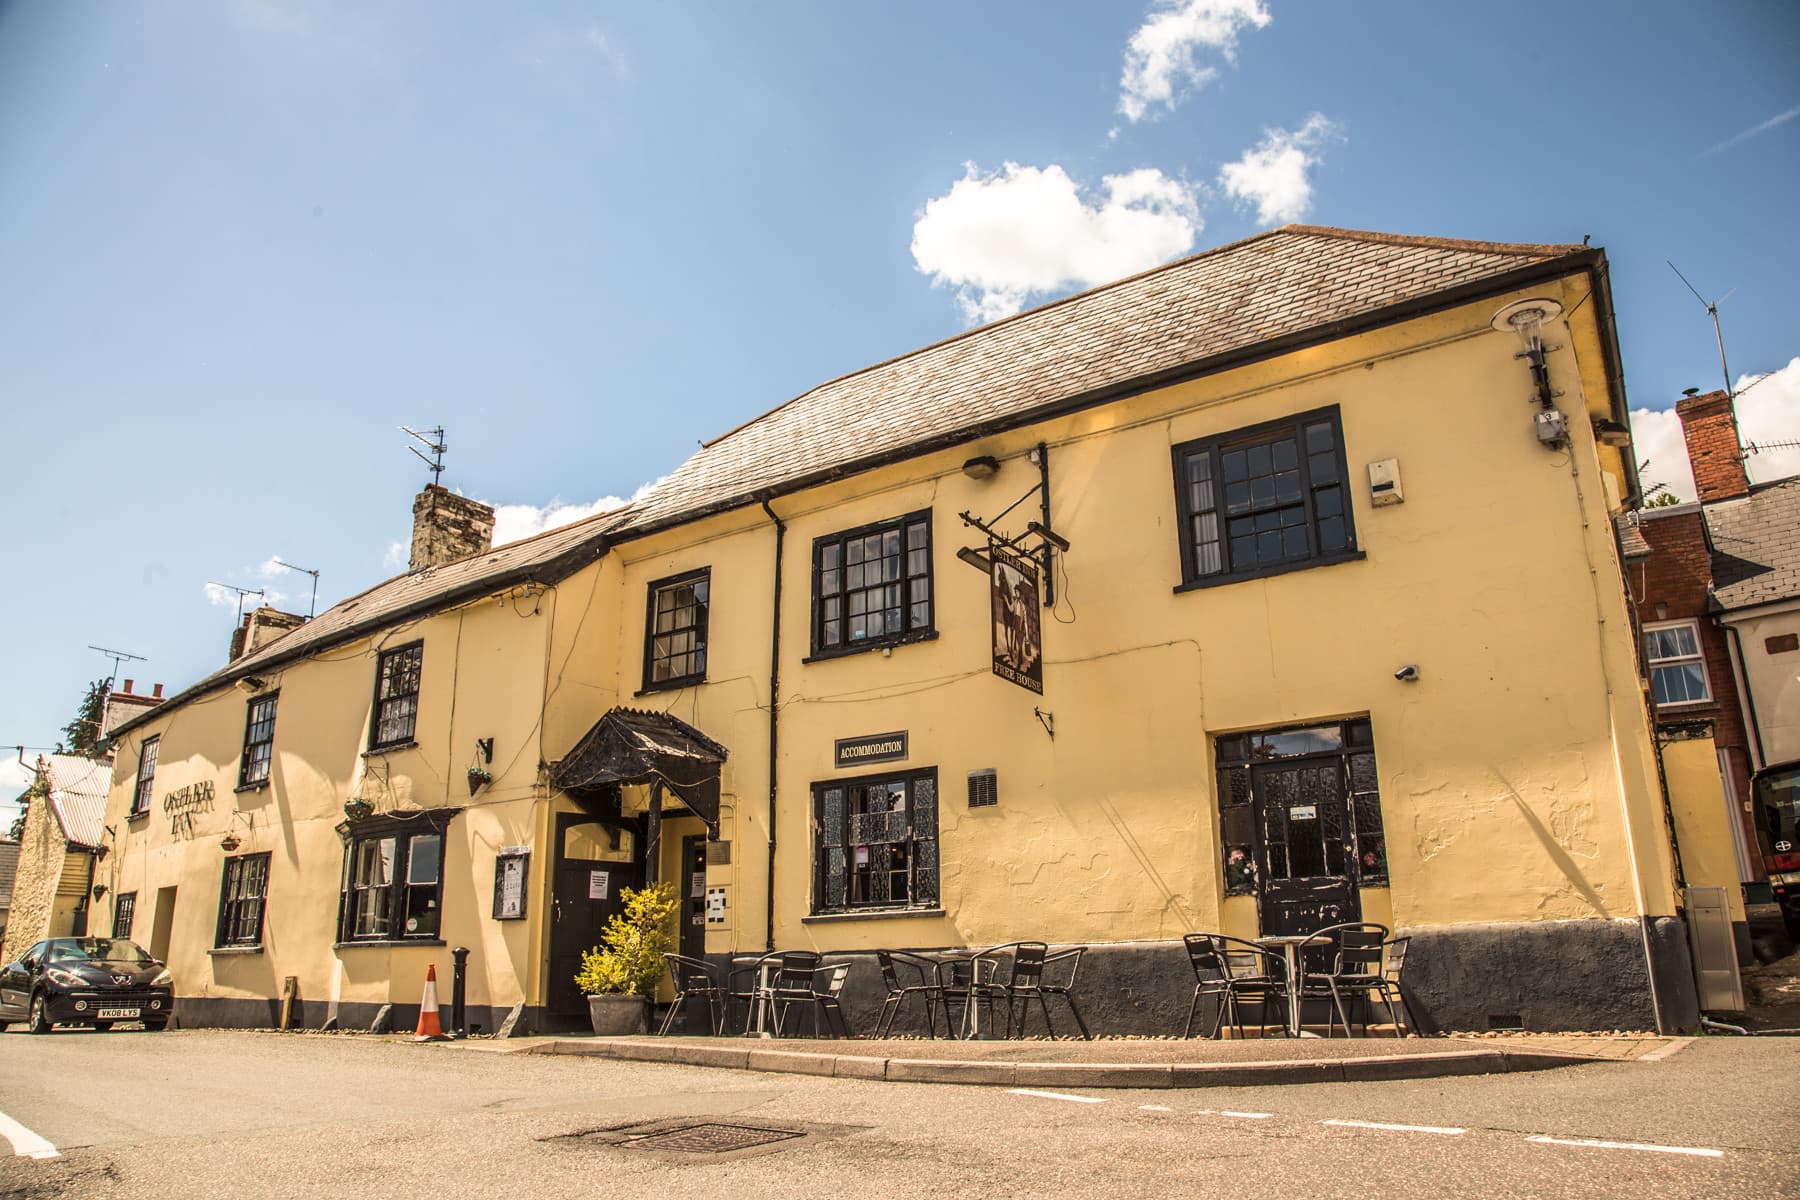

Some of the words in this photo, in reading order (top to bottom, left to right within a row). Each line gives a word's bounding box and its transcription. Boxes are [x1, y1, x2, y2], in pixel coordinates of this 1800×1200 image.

[993, 546, 1021, 571] OSTLER
[994, 661, 1015, 680] FREE
[1016, 672, 1042, 692] HOUSE
[840, 740, 902, 759] ACCOMMODATION
[164, 780, 215, 812] OSTLER
[123, 1009, 138, 1017] LYS
